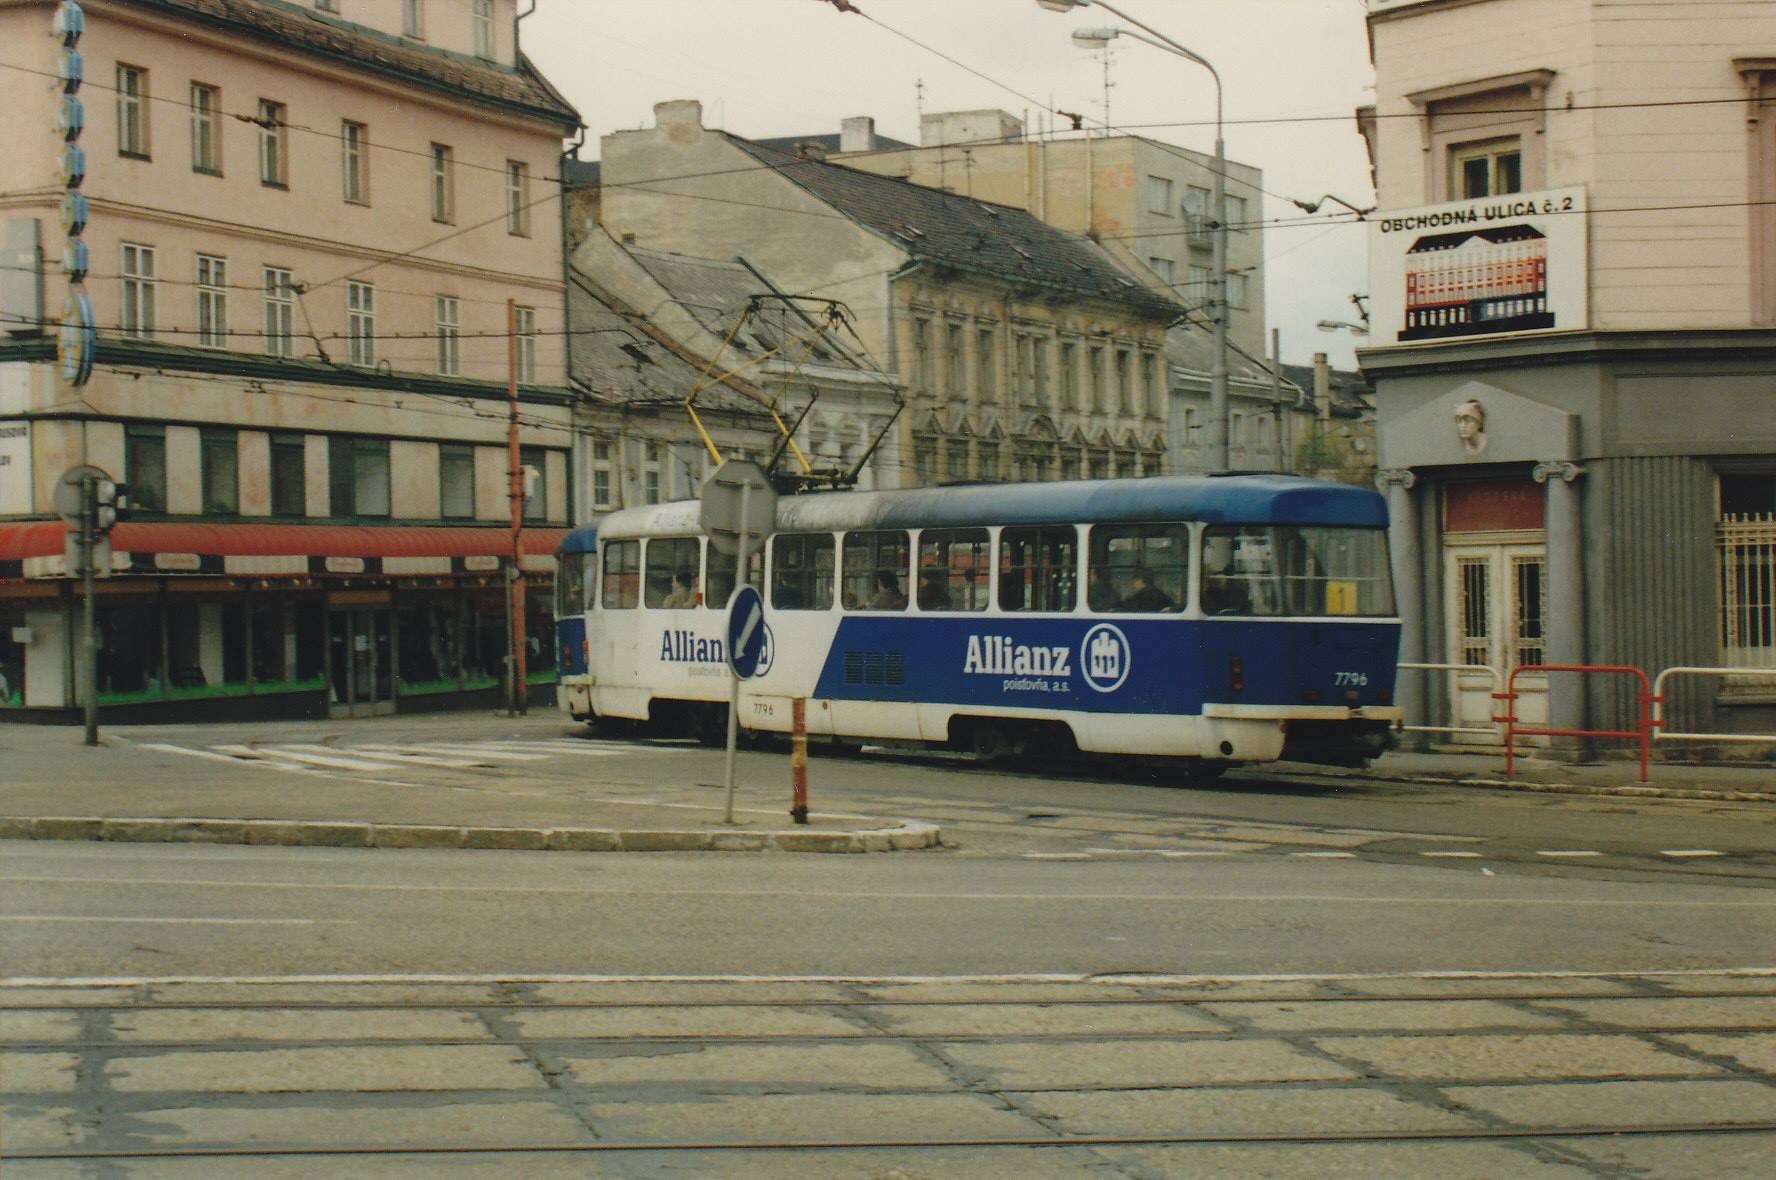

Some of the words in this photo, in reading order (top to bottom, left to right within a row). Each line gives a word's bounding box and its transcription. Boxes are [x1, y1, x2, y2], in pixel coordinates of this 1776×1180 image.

[1485, 201, 1537, 221] ULICA
[660, 630, 728, 663] Allian
[963, 635, 1071, 677] Allianz
[1335, 672, 1369, 686] 7796
[753, 703, 775, 716] 7796
